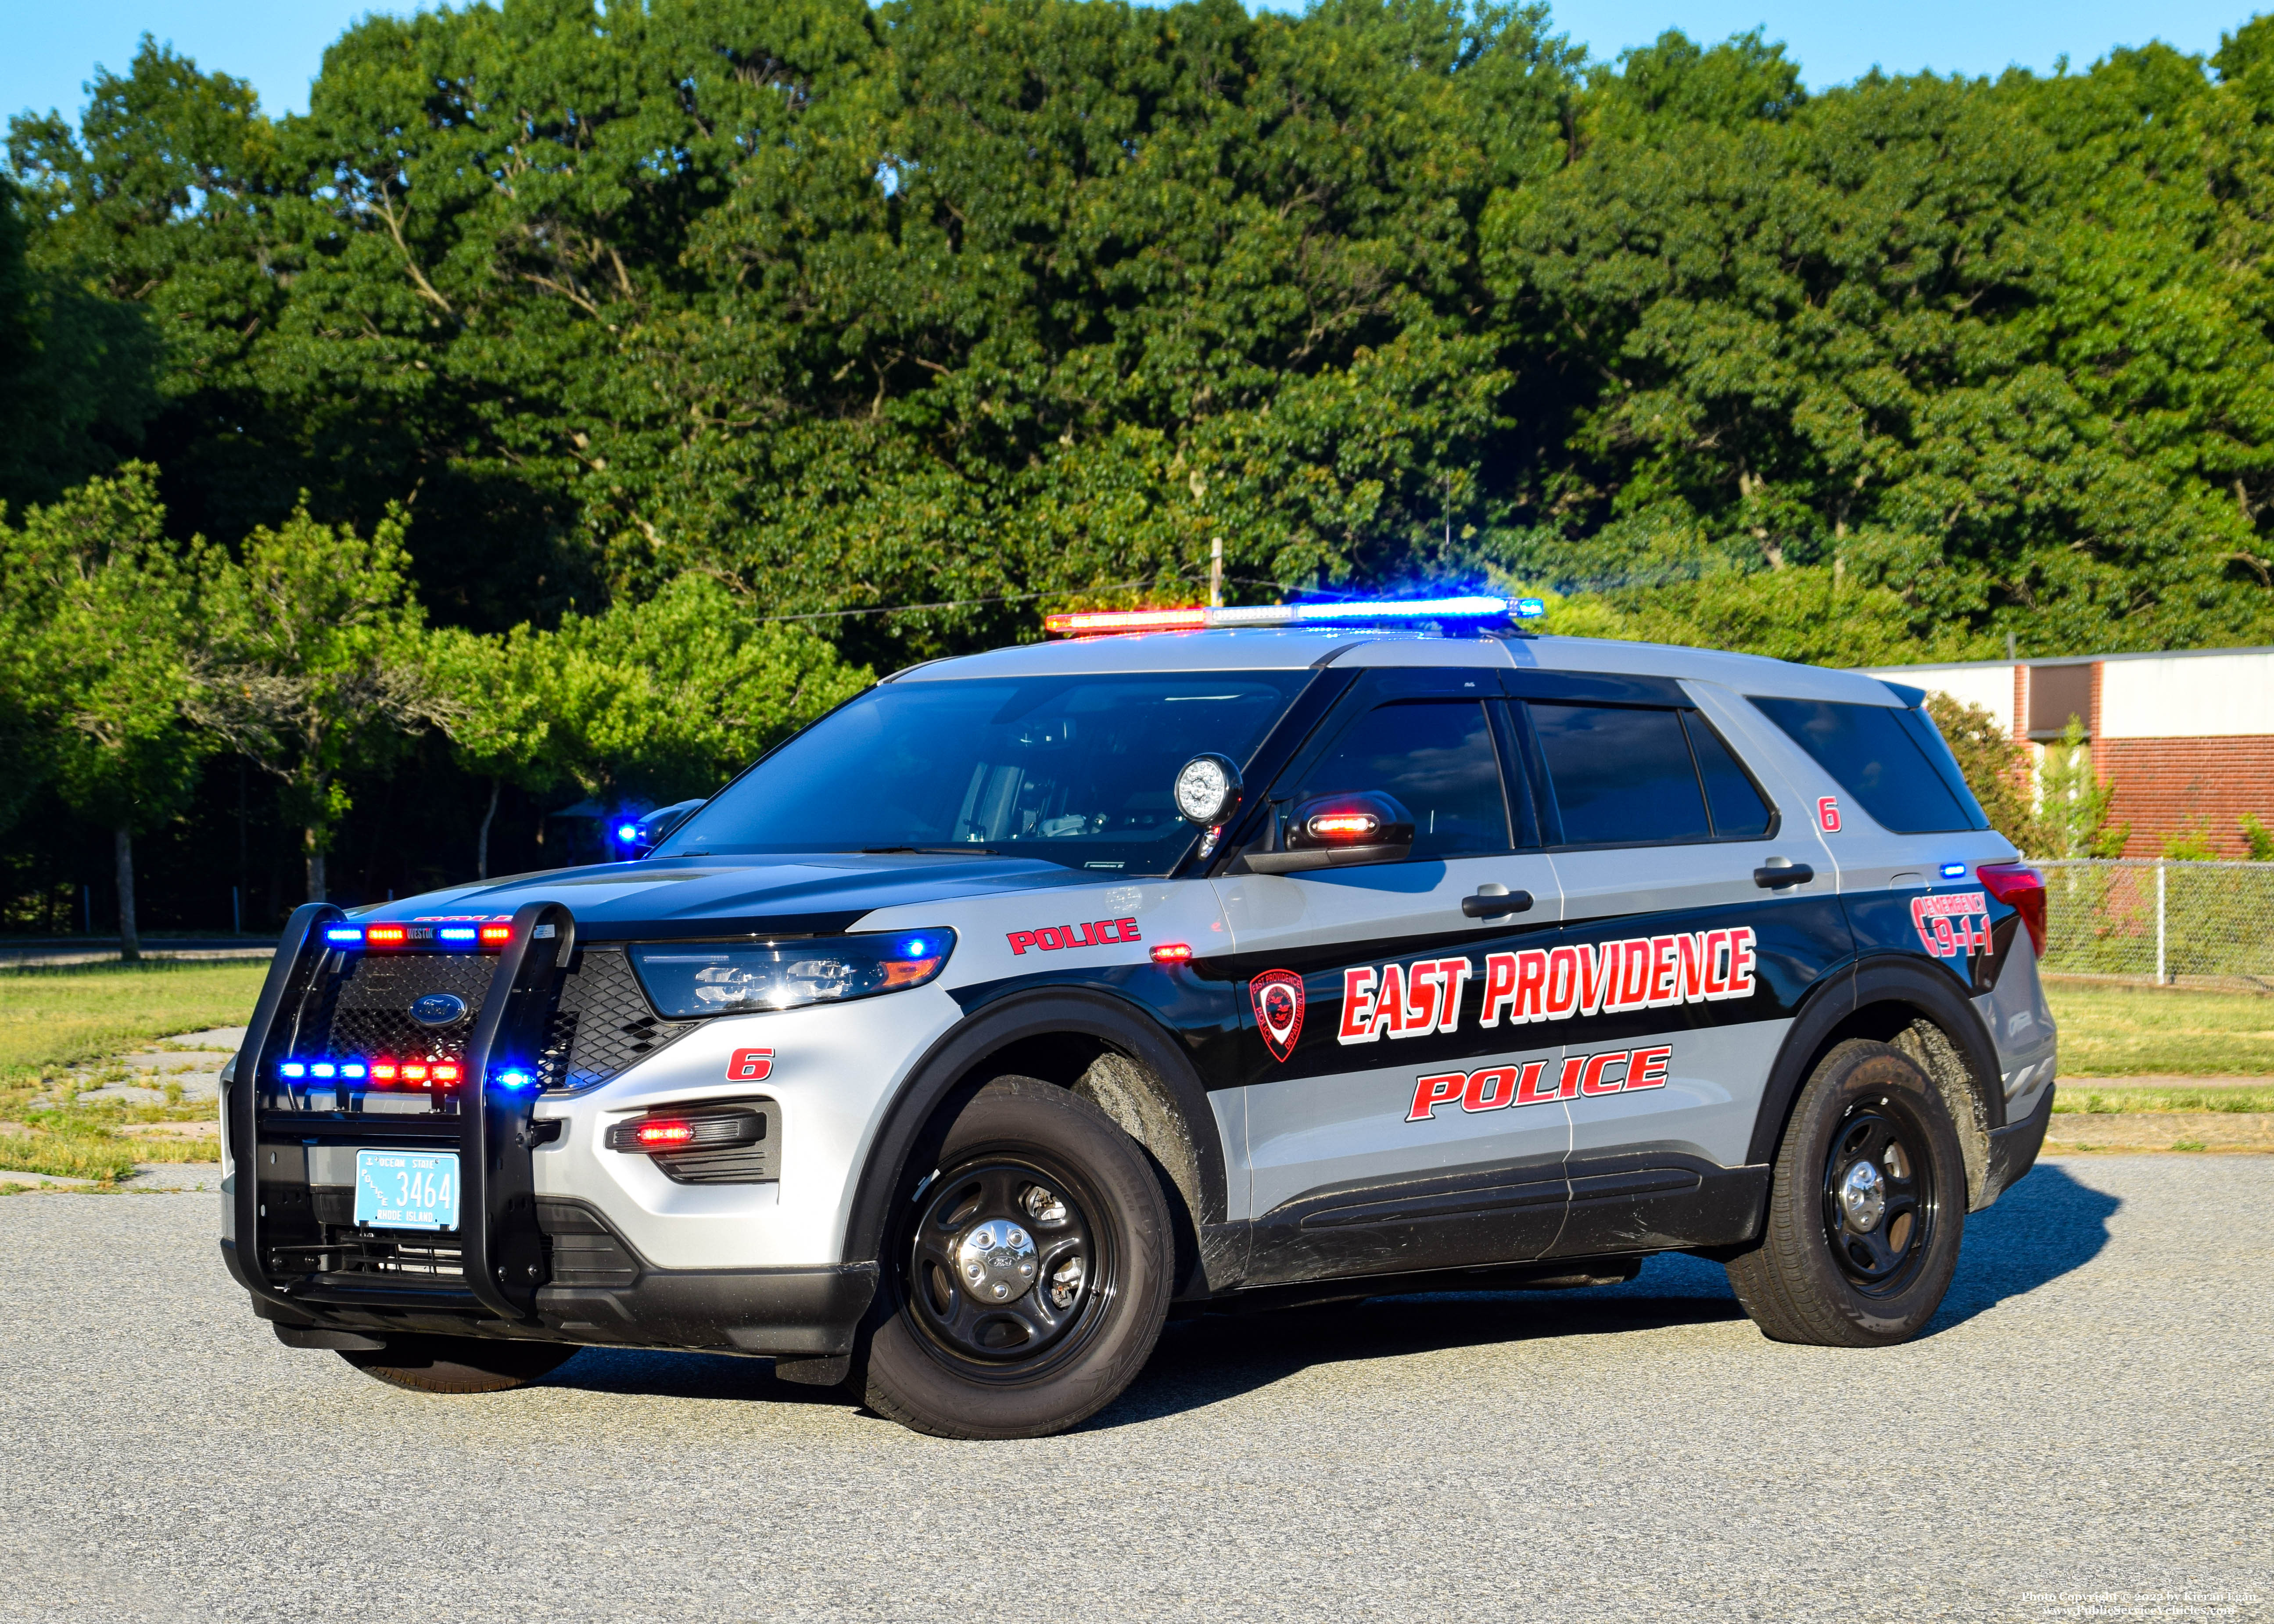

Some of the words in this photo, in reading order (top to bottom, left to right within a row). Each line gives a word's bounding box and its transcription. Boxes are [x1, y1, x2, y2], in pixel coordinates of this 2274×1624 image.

[1817, 796, 1841, 832] 6
[1922, 891, 1987, 918] EMERGENCY
[1006, 917, 1141, 955] POLICE
[1932, 914, 1994, 957] 9-1-1
[1252, 977, 1265, 994] EAST
[1266, 973, 1301, 989] PROVIDENCE
[1338, 957, 1472, 1045] EAST
[1479, 926, 1757, 1028] PROVIDENCE
[1255, 1007, 1274, 1043] POLICE
[1284, 991, 1303, 1050] DEPARTMENT
[726, 1047, 775, 1082] 6
[1405, 1044, 1672, 1122] POLICE
[379, 1158, 405, 1168] OCEAN
[412, 1159, 434, 1169] STATE
[361, 1169, 388, 1206] POLICE
[396, 1172, 450, 1209] 3464
[377, 1209, 402, 1221] RHODE
[406, 1211, 433, 1222] ISLAND
[994, 1258, 1012, 1266] Ford
